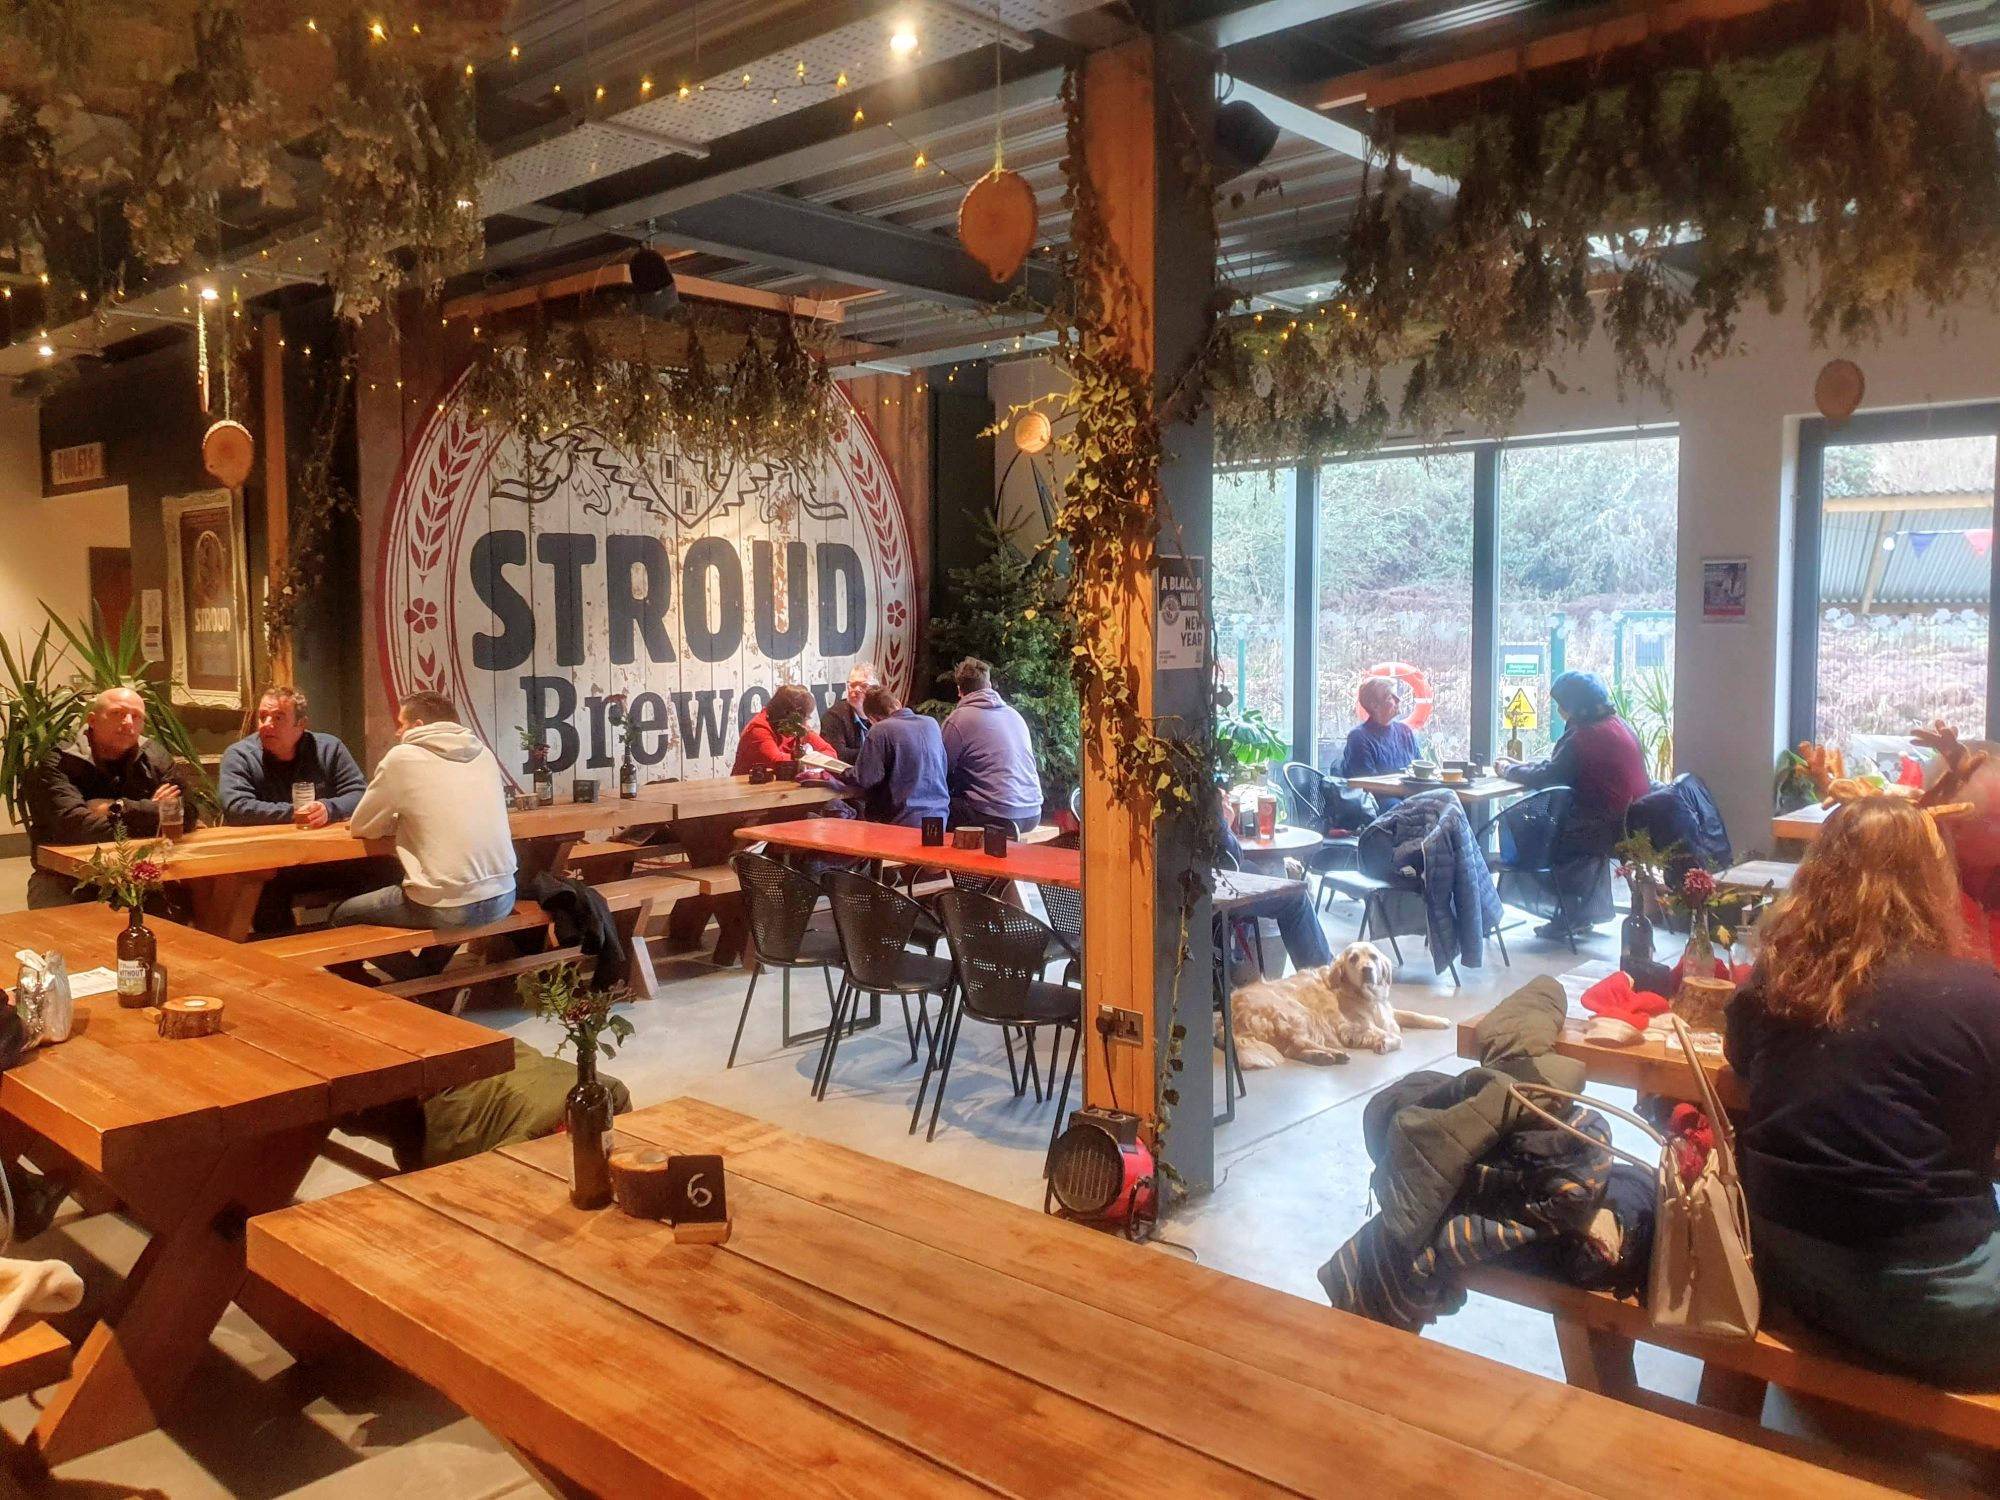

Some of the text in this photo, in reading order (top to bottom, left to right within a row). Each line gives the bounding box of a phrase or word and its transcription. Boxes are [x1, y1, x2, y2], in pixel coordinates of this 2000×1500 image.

[1161, 576, 1168, 590] A
[1170, 576, 1194, 590] BLAC
[470, 530, 866, 671] STROUD
[195, 607, 230, 632] STROUD
[1185, 616, 1202, 630] NEW
[1181, 632, 1202, 647] YEAR
[519, 675, 847, 774] Brewey
[687, 1172, 712, 1208] 6
